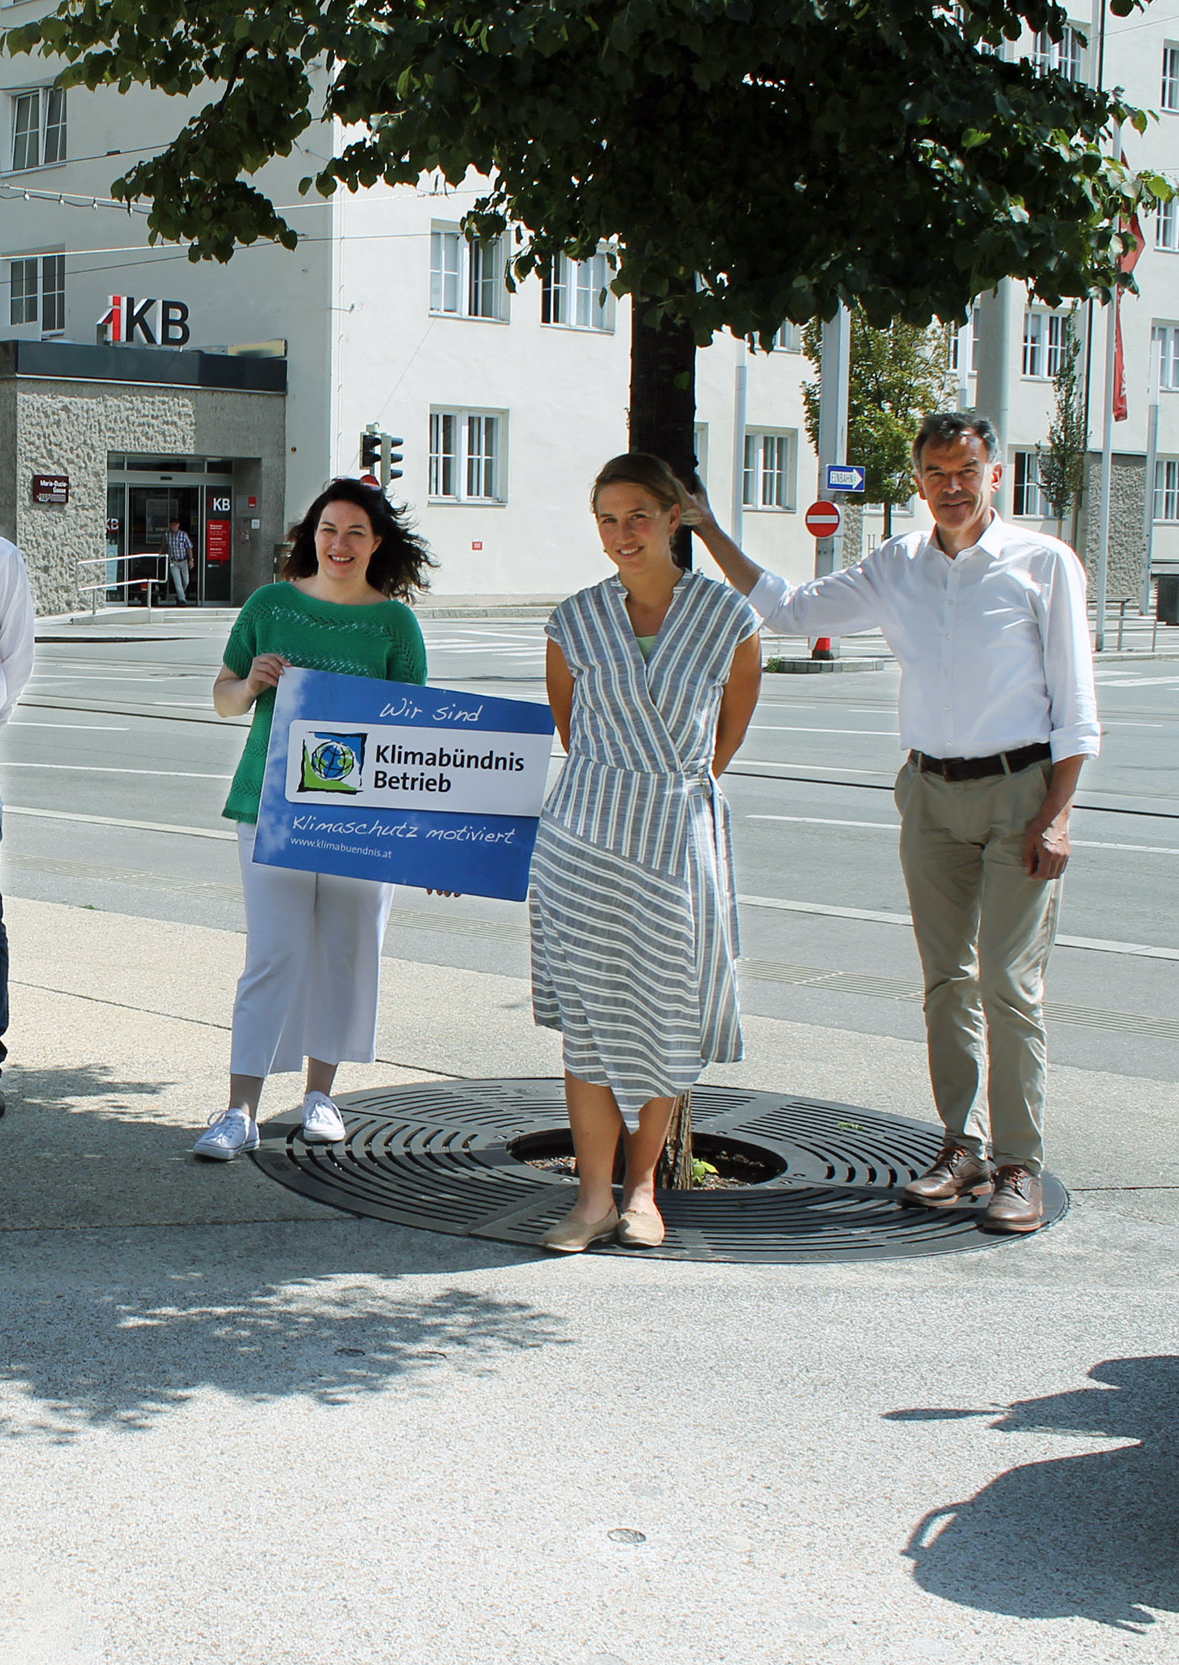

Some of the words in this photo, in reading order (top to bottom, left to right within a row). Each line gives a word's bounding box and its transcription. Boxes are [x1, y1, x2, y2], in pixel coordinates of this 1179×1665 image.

[379, 698, 422, 719] Wir
[432, 704, 484, 722] sind
[375, 745, 525, 772] Klimabündnis
[373, 770, 452, 793] Betrieb
[292, 816, 418, 838] Klimaschutz
[425, 826, 517, 844] motiviert
[290, 836, 393, 859] www.klimabuendnis.at
